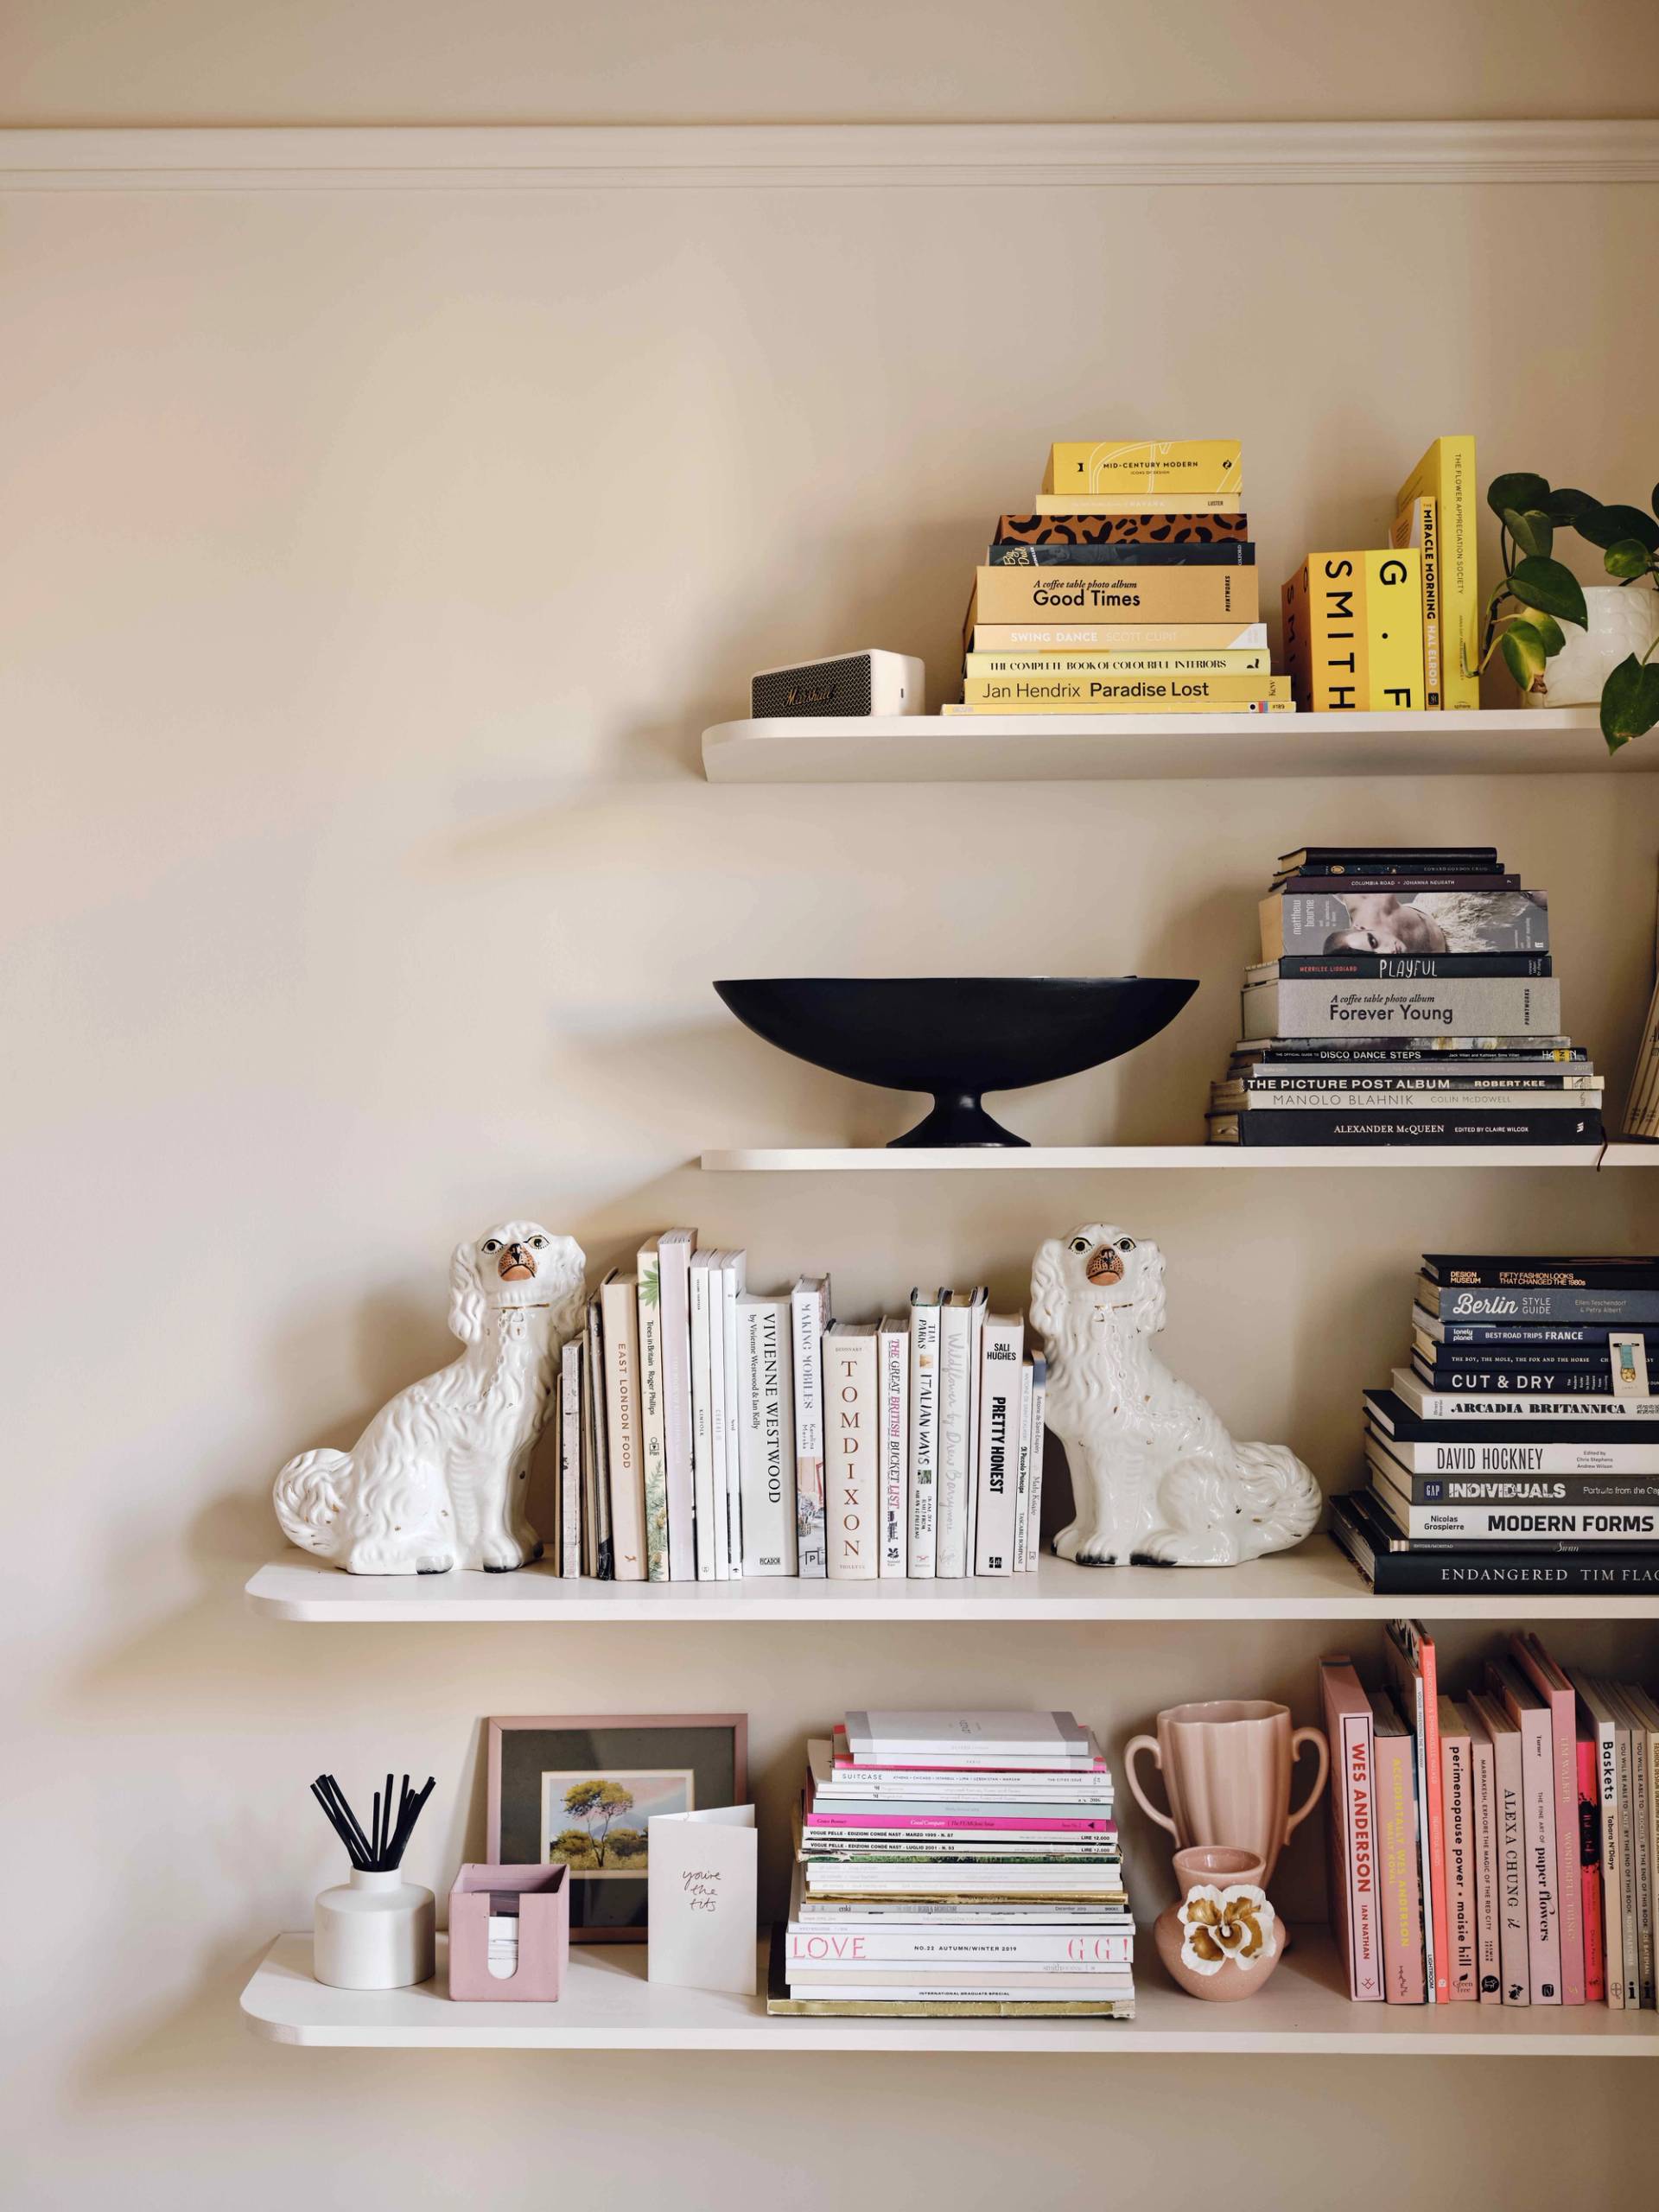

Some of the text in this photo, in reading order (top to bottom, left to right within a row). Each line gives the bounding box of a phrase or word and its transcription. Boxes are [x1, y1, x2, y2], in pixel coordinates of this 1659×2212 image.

[1042, 580, 1137, 590] coffee table photo album
[1033, 588, 1141, 607] Good Times
[1424, 510, 1438, 685] MIRACLE MORNING ELROD
[1010, 632, 1098, 642] SWING DANCE
[1325, 560, 1356, 709] SMITH
[1066, 660, 1227, 671] BOOK INTERIORS
[982, 682, 1210, 698] Jan Hendrix Paradise Lost
[1379, 959, 1438, 978] PLAYFUL
[1339, 994, 1435, 1005] coffee table photo album
[1330, 1004, 1453, 1025] Forever Young
[1319, 1051, 1421, 1059] DISCO DANCE STEPS
[1248, 1080, 1277, 1089] THE
[1281, 1080, 1347, 1090] PICTURE
[1351, 1080, 1393, 1089] POST
[1395, 1079, 1450, 1090] ALBUM
[1273, 1095, 1341, 1105] MANOLO
[1349, 1095, 1413, 1105] BLAHNIK
[1396, 1125, 1445, 1135] McQUEEN
[1452, 1293, 1519, 1315] Berlin
[1522, 1297, 1551, 1306] STYLE
[1522, 1306, 1551, 1314] GUIDE
[917, 1319, 927, 1350] PARKS
[1545, 1332, 1584, 1340] FRANCE
[801, 1303, 814, 1409] MAKING MOBILES
[987, 1351, 1016, 1361] HUGHES
[994, 1343, 1010, 1351] SALI
[941, 1332, 964, 1408] Wildflower
[1452, 1374, 1555, 1389] CUT & DRY
[618, 1344, 631, 1469] EAST LONDON FOOD
[763, 1313, 781, 1504] VIVIENNE WESTWOOD
[1451, 1403, 1523, 1414] ARCADIA
[1529, 1403, 1626, 1414] BRITANNICA
[751, 1412, 760, 1429] Kelly
[890, 1338, 900, 1510] THE GREAT BRITISH BUCKET LIST
[918, 1374, 932, 1465] ITALIAN WAYS
[989, 1396, 1007, 1494] PRETTY HONEST
[1019, 1452, 1027, 1471] Piccolo
[1437, 1447, 1543, 1471] DAVID HOCKNEY
[1426, 1484, 1440, 1497] GAP
[1448, 1483, 1567, 1499] INDIVIDUALS
[1430, 1515, 1459, 1523] Nicolas
[1488, 1515, 1654, 1532] MODERN FORMS
[1441, 1568, 1614, 1581] ENDANGERED TIM
[1560, 1737, 1569, 1756] TIM
[1351, 1743, 1367, 1783] WES
[1603, 1741, 1614, 1800] Baskets
[1353, 1789, 1371, 1892] ANDERSON
[1504, 1789, 1519, 1907] ALEXA CHUNG
[1396, 1849, 1408, 1873] WES
[1448, 1746, 1472, 1967] perimenopause power maisie hill
[1535, 1847, 1547, 1887] paper
[690, 1885, 718, 1896] the
[690, 1897, 716, 1912] tits
[1539, 1891, 1556, 1942] flowers
[792, 1936, 867, 1960] LOVE
[1362, 1923, 1370, 1960] NATHAN
